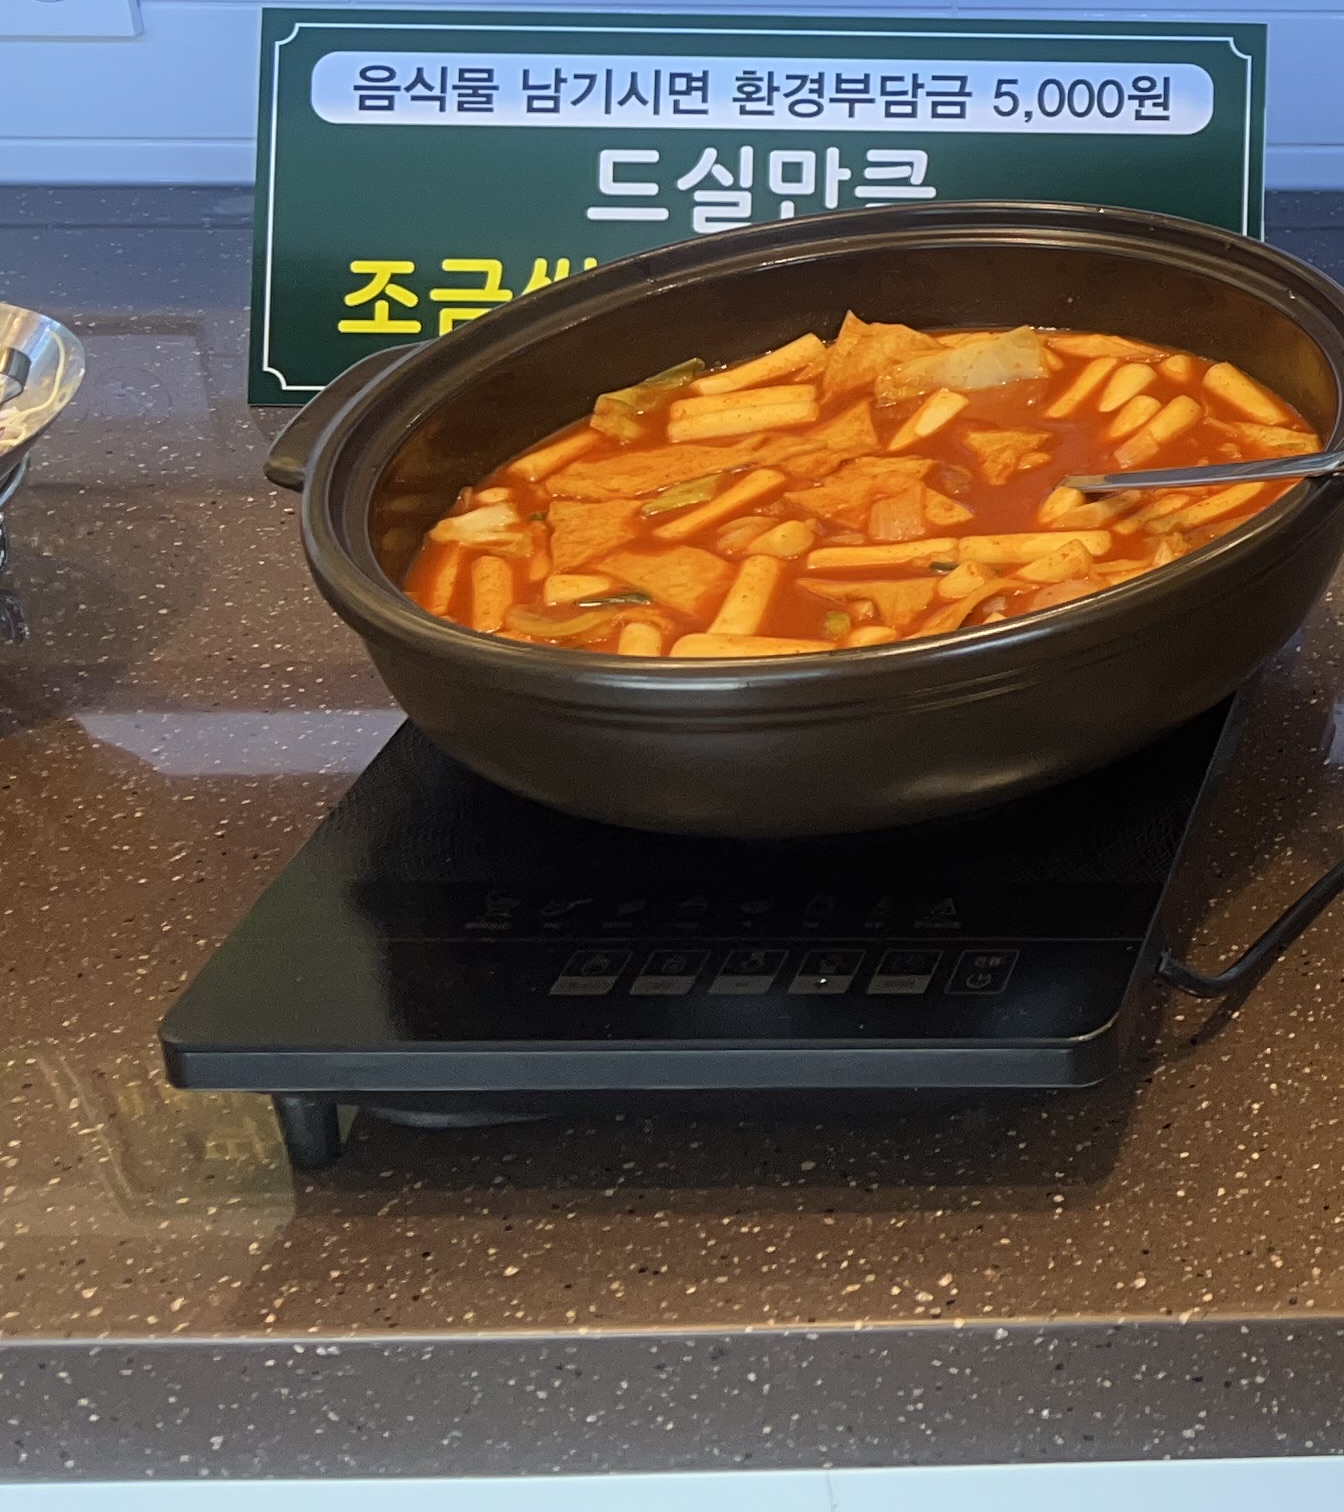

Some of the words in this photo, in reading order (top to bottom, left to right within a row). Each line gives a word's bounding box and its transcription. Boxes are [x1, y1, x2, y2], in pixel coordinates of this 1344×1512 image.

[353, 64, 501, 114] 음식물
[520, 67, 711, 117] 남기시면
[731, 69, 973, 120] 환경부담금
[991, 74, 1172, 123] 5,000원
[337, 256, 599, 338] 조금
